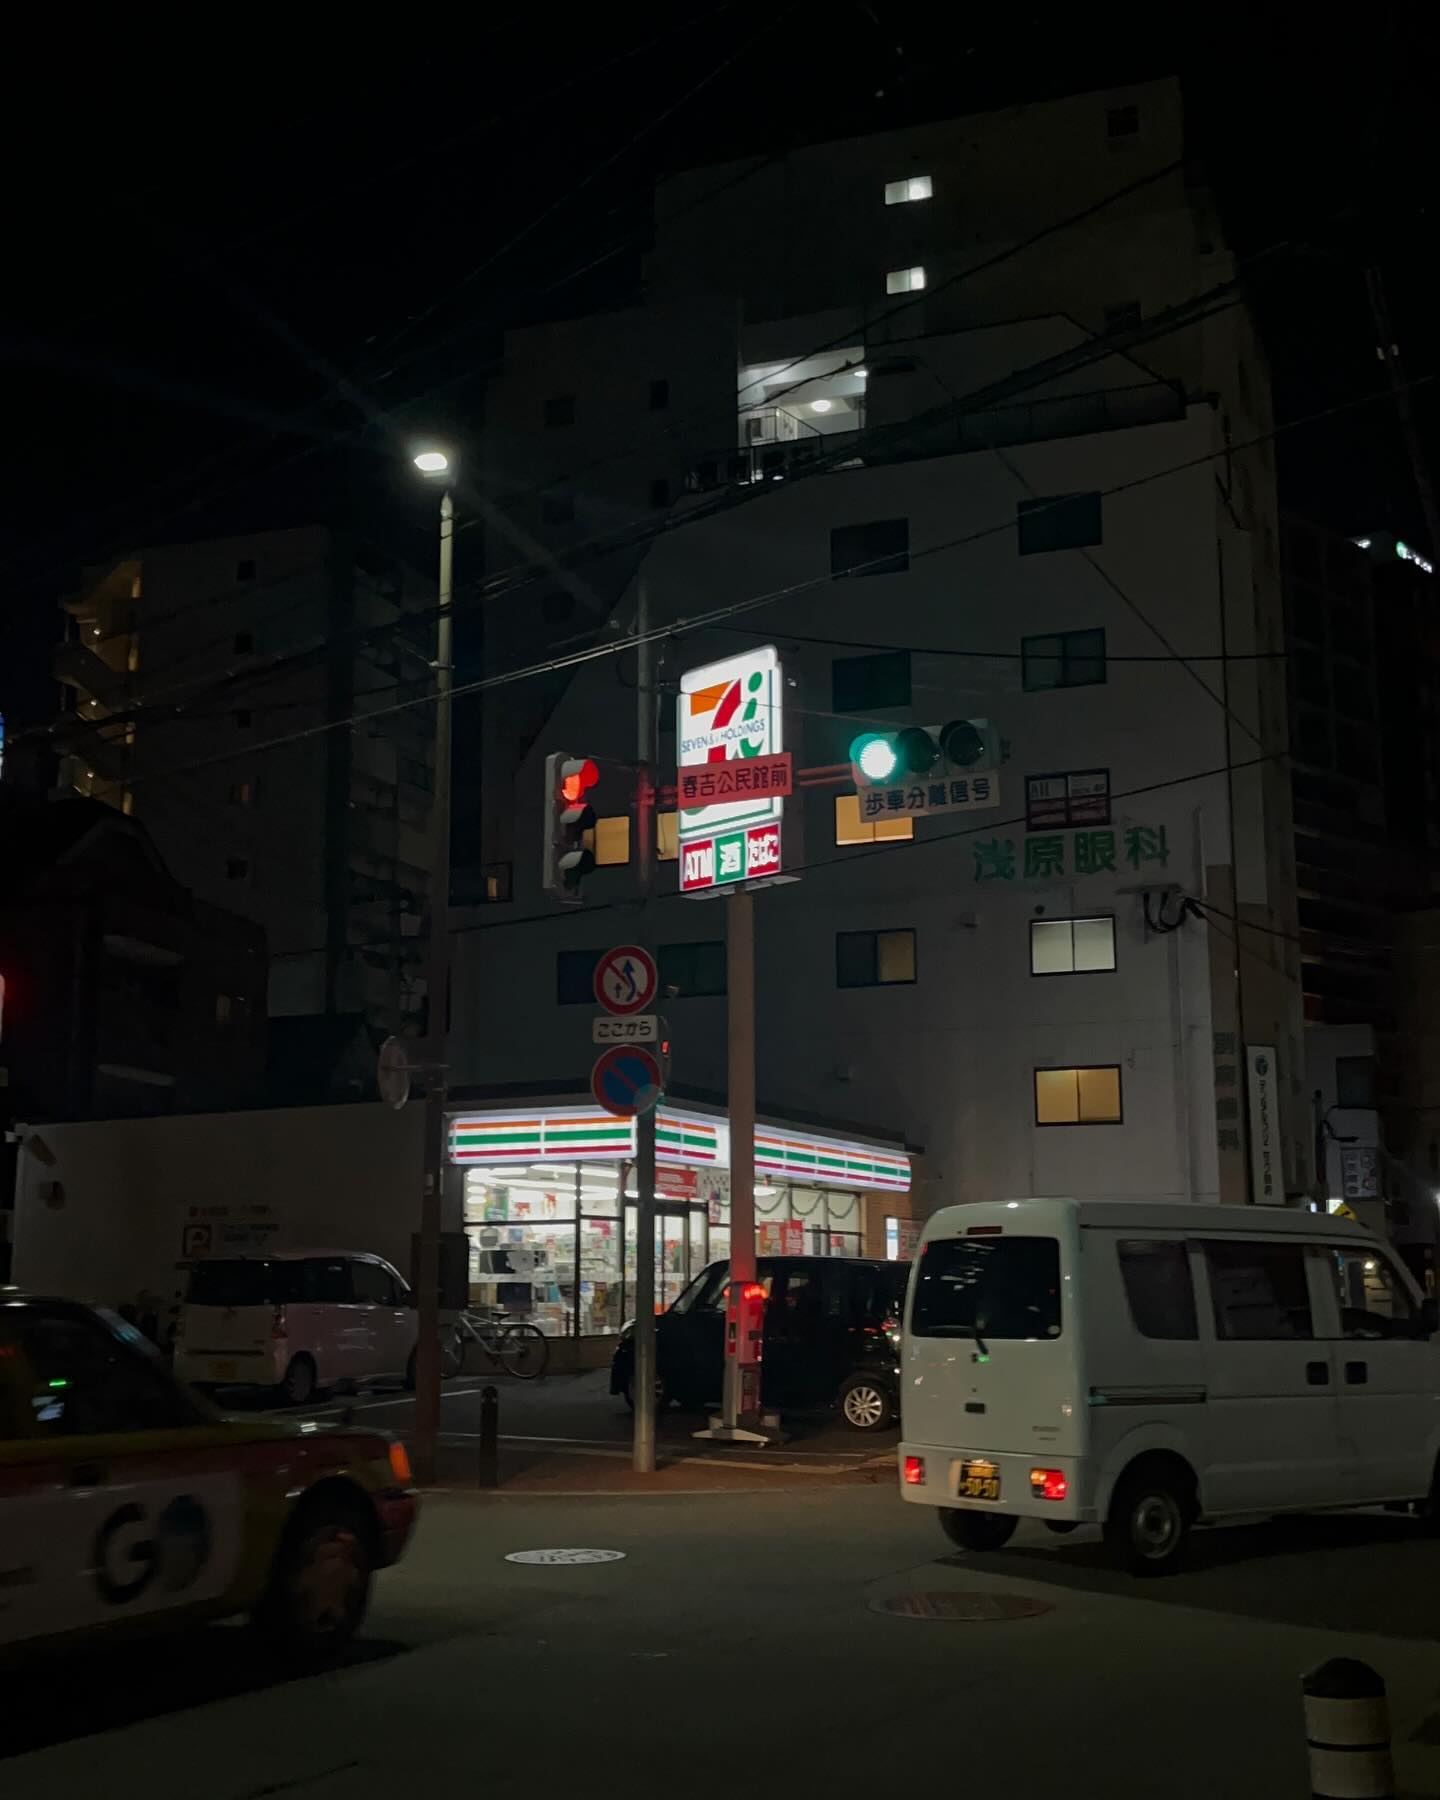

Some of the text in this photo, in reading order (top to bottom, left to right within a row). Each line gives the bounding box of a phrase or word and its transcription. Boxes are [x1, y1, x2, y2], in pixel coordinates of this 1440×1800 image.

[720, 719, 765, 740] HOLDINGS
[683, 763, 787, 798] 春吉公民館前
[864, 777, 991, 816] 歩車分離信号
[973, 824, 1169, 882] 浅原眼科
[598, 1021, 652, 1037] ここから
